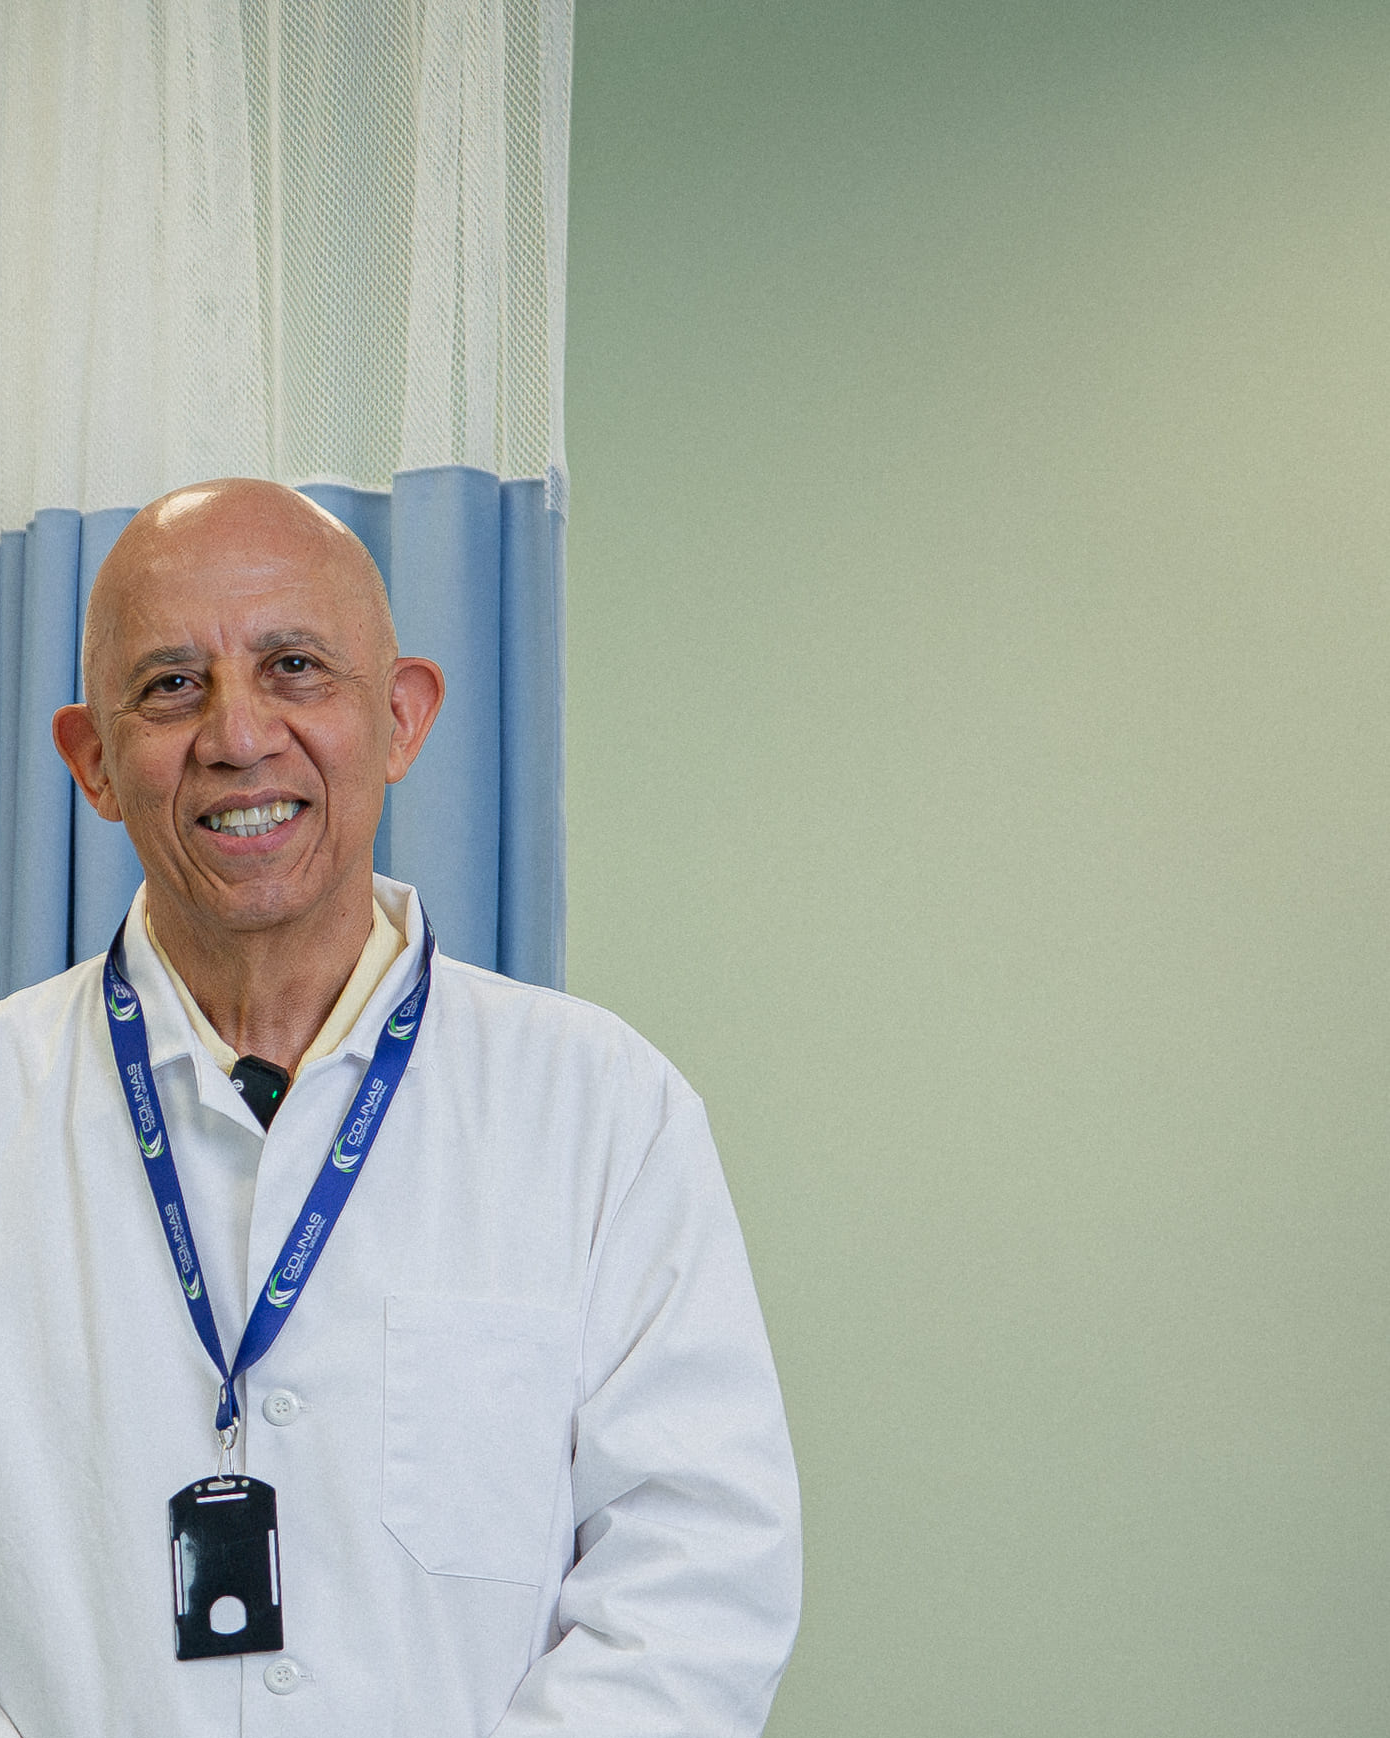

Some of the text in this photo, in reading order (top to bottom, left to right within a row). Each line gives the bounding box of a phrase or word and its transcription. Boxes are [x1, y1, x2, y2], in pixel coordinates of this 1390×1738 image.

[126, 1062, 152, 1133] COLINAS
[346, 1077, 384, 1146] COLINAS
[164, 1203, 191, 1274] COLINAS
[282, 1211, 322, 1282] COLINAS
